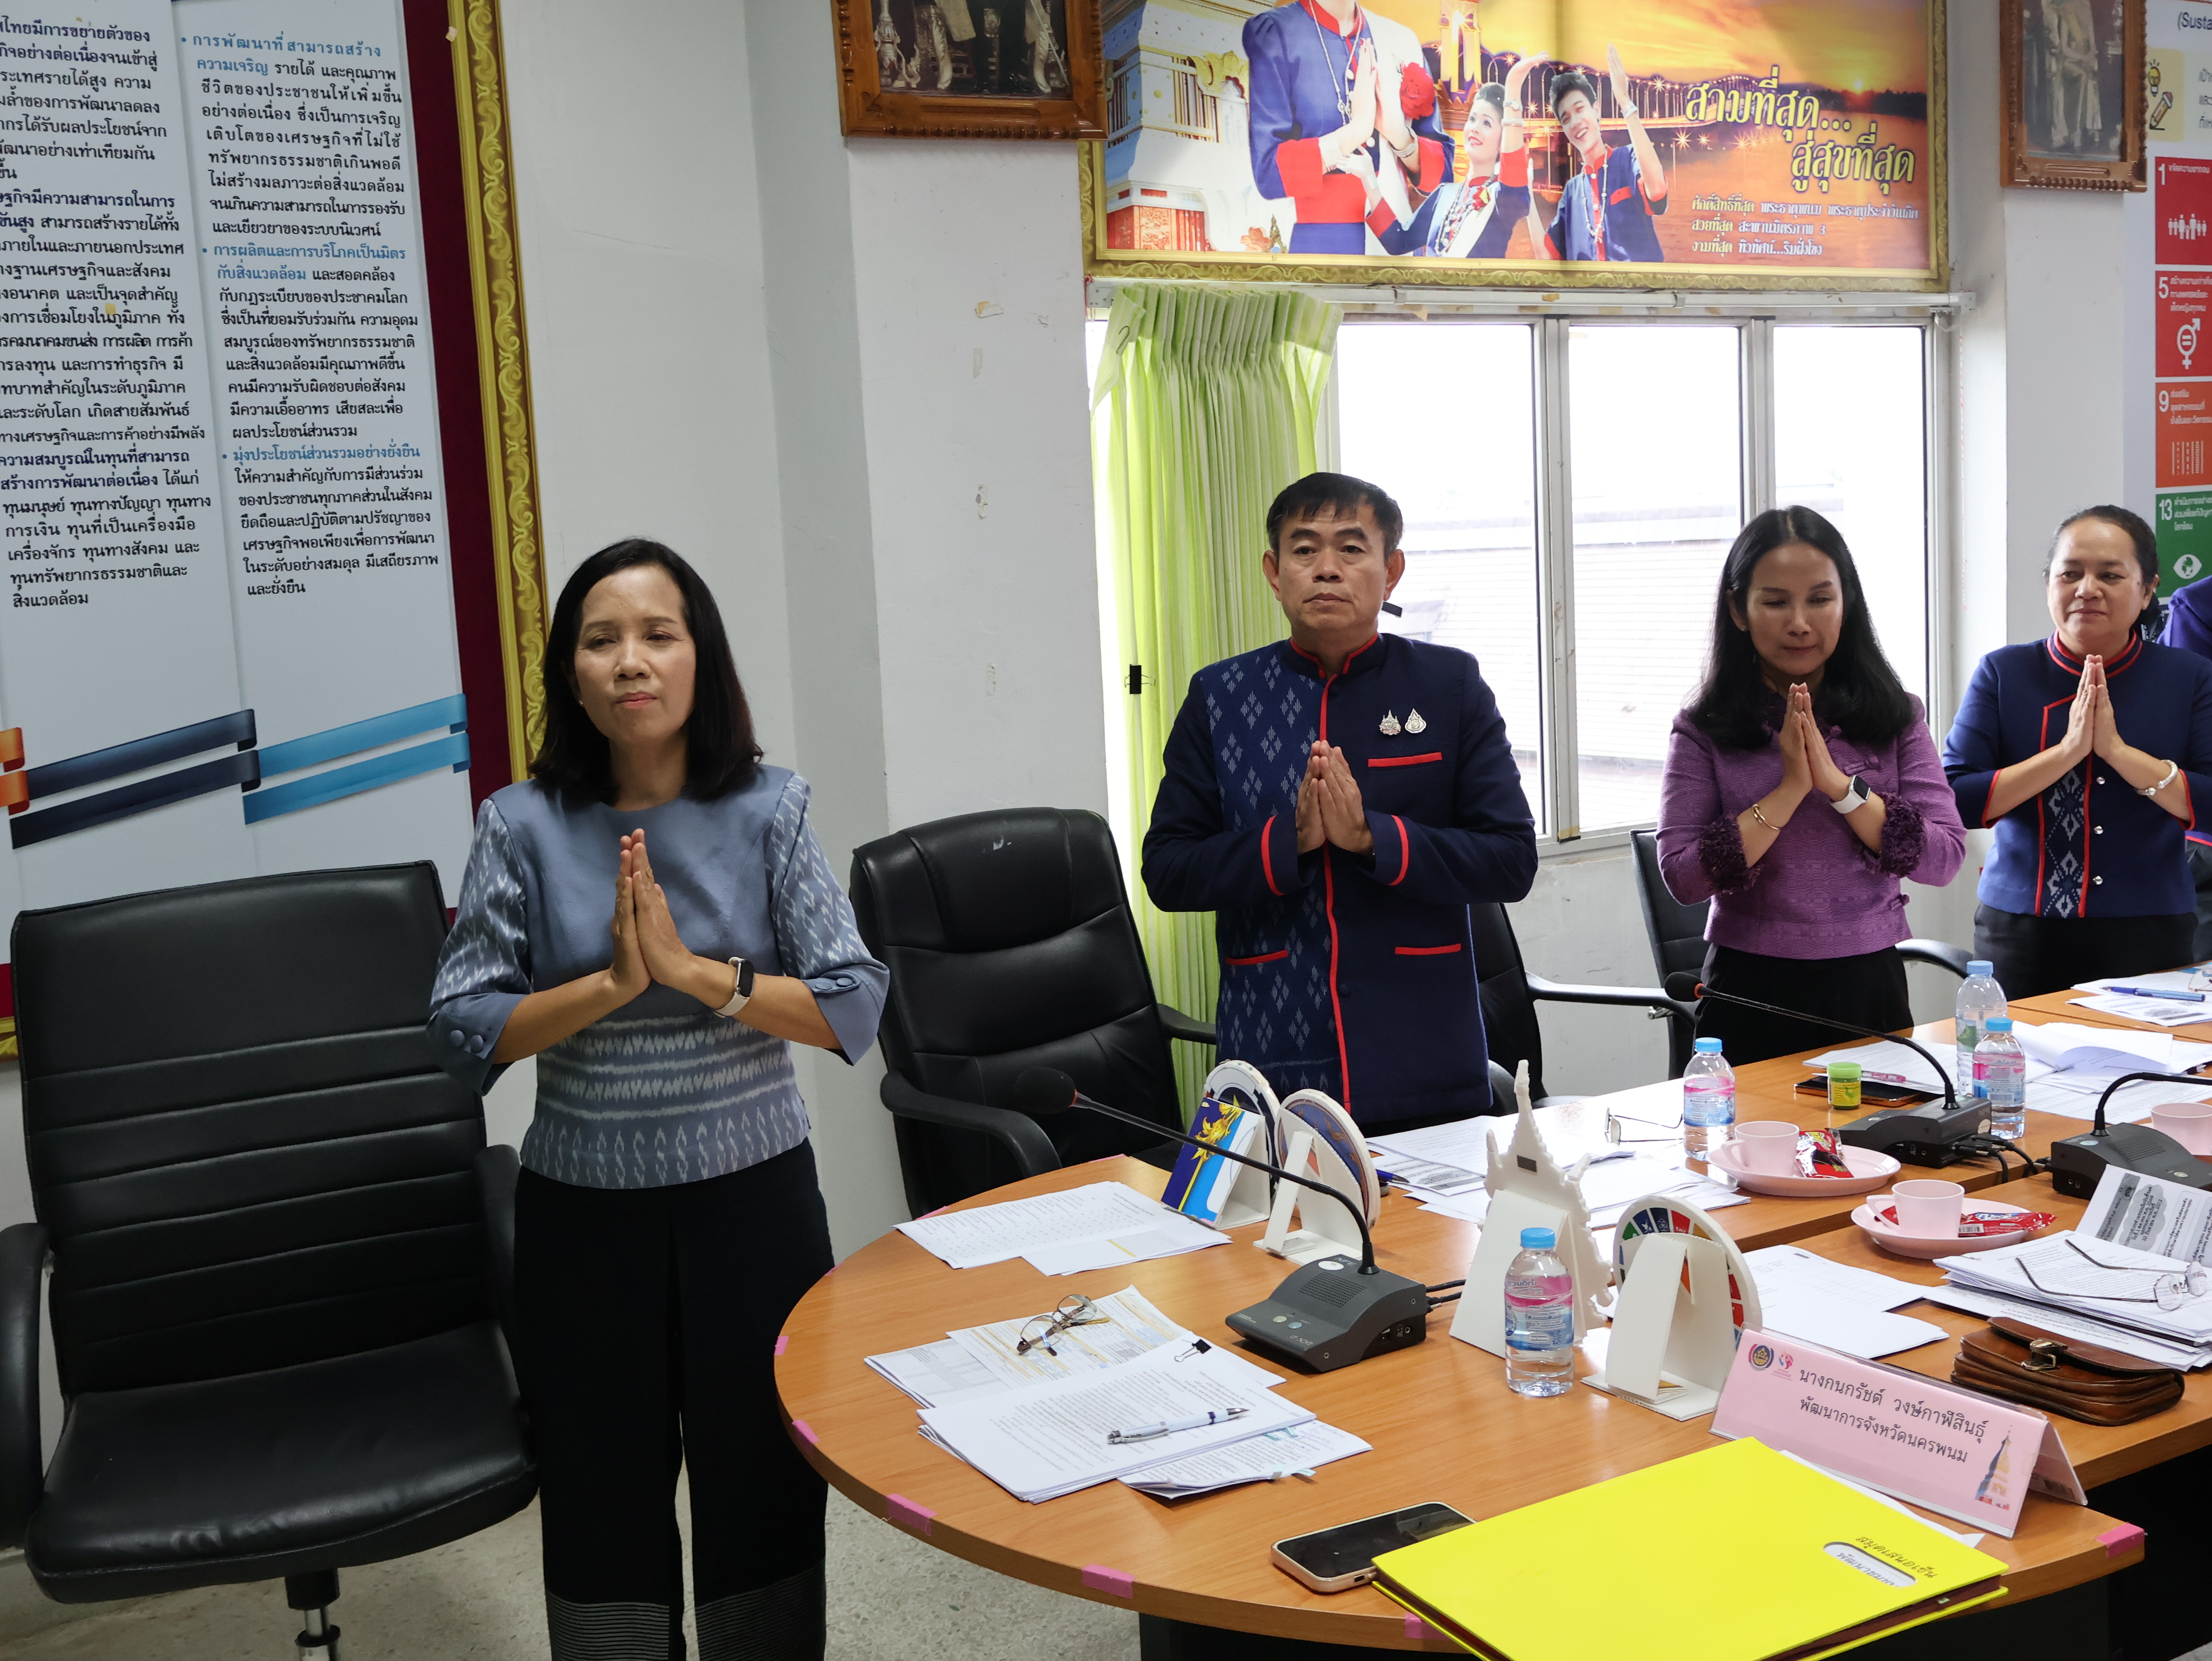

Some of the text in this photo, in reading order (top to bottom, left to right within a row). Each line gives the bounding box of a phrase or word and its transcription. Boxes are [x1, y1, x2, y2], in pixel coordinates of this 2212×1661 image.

[197, 58, 396, 83] ความเจริญ รายได้ และคุณภาพ
[114, 77, 152, 90] ความ
[202, 99, 401, 128] อย่างต่อเนื่อง ซึ่งเป็นการเจริญ
[206, 124, 401, 149] เติบโตของเศรษฐกิจที่ไม่ใช้
[208, 149, 401, 171] ทรัพยากรธรรมชาติเกินพอดี
[1791, 122, 1916, 196] สู่สุขที่สุด
[208, 169, 404, 193] ไม่สร้างมลภาวะต่อสิ่งแวดล้อม
[2158, 163, 2166, 186] 1
[210, 196, 405, 216] จนเกินความสามารถในการรองรับ
[41, 211, 179, 231] สามารถสร้างรายได้ทั้ง
[213, 218, 381, 237] และเยียวยาของระบบนิเวศน์
[1691, 213, 1826, 236] สวยที่สุด สะพานมิตรภาพ 3
[0, 235, 184, 255] ภายในและภายนอกประเทศ
[214, 241, 406, 260] การผลิตและการบริโภคเป็นมิตร
[1691, 234, 1733, 257] งามที่สุด
[217, 259, 395, 282] กับสิ่งแวดล้อม และสอดคล้อง
[67, 284, 178, 306] และเป็นจุดสำคัญ
[2158, 277, 2169, 299] 5
[0, 303, 185, 328] งการเชื่อมโยงในภูมิภาค ทั้ง
[221, 305, 418, 330] ซึ่งเป็นที่ยอมรับร่วมกัน ความอุดม
[0, 332, 193, 347] รคมนาคมขนส่ง การผลิต การค้า
[224, 333, 415, 353] สมบูรณ์ของทรัพยากรธรรมชาติ
[62, 356, 166, 376] และการทำธุรกิจ
[173, 355, 184, 370] มี
[226, 351, 406, 375] และสิ่งแวดล้อมมีคุณภาพดีขึ้น
[228, 377, 406, 394] คนมีความรับผิดชอบต่อสังคม
[88, 401, 189, 417] เกิดสายสัมพันธ์
[230, 395, 403, 416] มีความเอื้ออาทร เสียสละเพื่อ
[2158, 390, 2170, 412] 9
[233, 421, 357, 439] ผลประโยชน์ส่วนรวม
[232, 439, 420, 466] มุ่งประโยชน์ส่วนรวมอย่างยั่งยืน
[0, 466, 199, 490] สร้างการพัฒนาต่อเนื่อง ได้แก่
[234, 462, 423, 484] ให้ความสำคัญกับการมีส่วนร่วม
[3, 495, 211, 519] ทุนมนุษย์ ทุนทางปัญญา ทุนทาง
[239, 486, 433, 508] ของประชาชนทุกภาคส่วนในสังคม
[2158, 498, 2173, 521] 13
[6, 512, 196, 540] การเงิน ทุนที่เป็นเครื่องมือ
[243, 527, 435, 553] เศรษฐกิจพอเพียงเพื่อการพัฒนา
[8, 540, 200, 563] เครื่องจักร ทุนทางสังคม และ
[243, 553, 439, 573] ในระดับอย่างสมดุล มีเสถียรภาพ
[10, 563, 188, 589] ทุนทรัพยากรธรรมชาติและ
[247, 576, 306, 595] และยั่งยืน
[13, 587, 89, 608] สิ่งแวดล้อม
[1799, 1369, 1989, 1444] นางกนกรัชต์ วงษ์กาฬสินธุ์
[1800, 1396, 1968, 1463] พัฒนาการจังหวัดนครพนม
